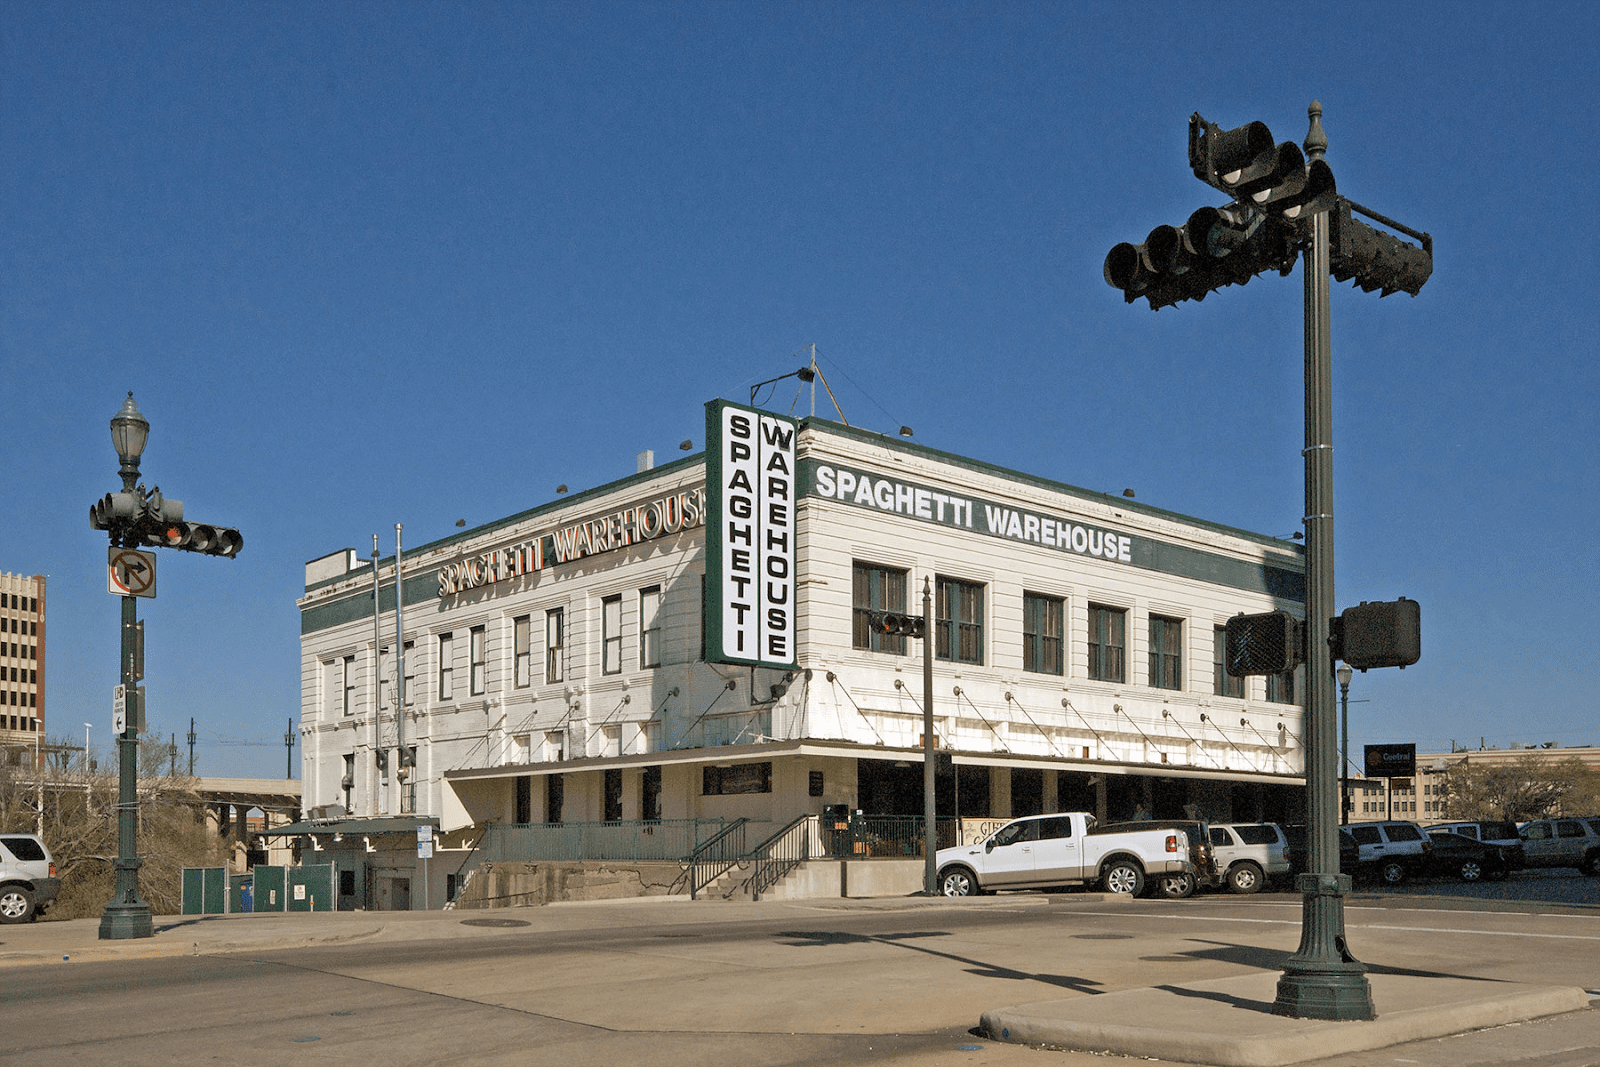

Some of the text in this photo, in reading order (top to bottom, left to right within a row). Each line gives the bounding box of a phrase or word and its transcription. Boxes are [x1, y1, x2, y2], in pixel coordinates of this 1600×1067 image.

[438, 538, 544, 597] SPAGHETTI
[728, 415, 753, 652] SPAGHETTI
[761, 421, 794, 657] WAREHOUSE
[816, 465, 1131, 562] SPAGHETTI WAREHOUSE
